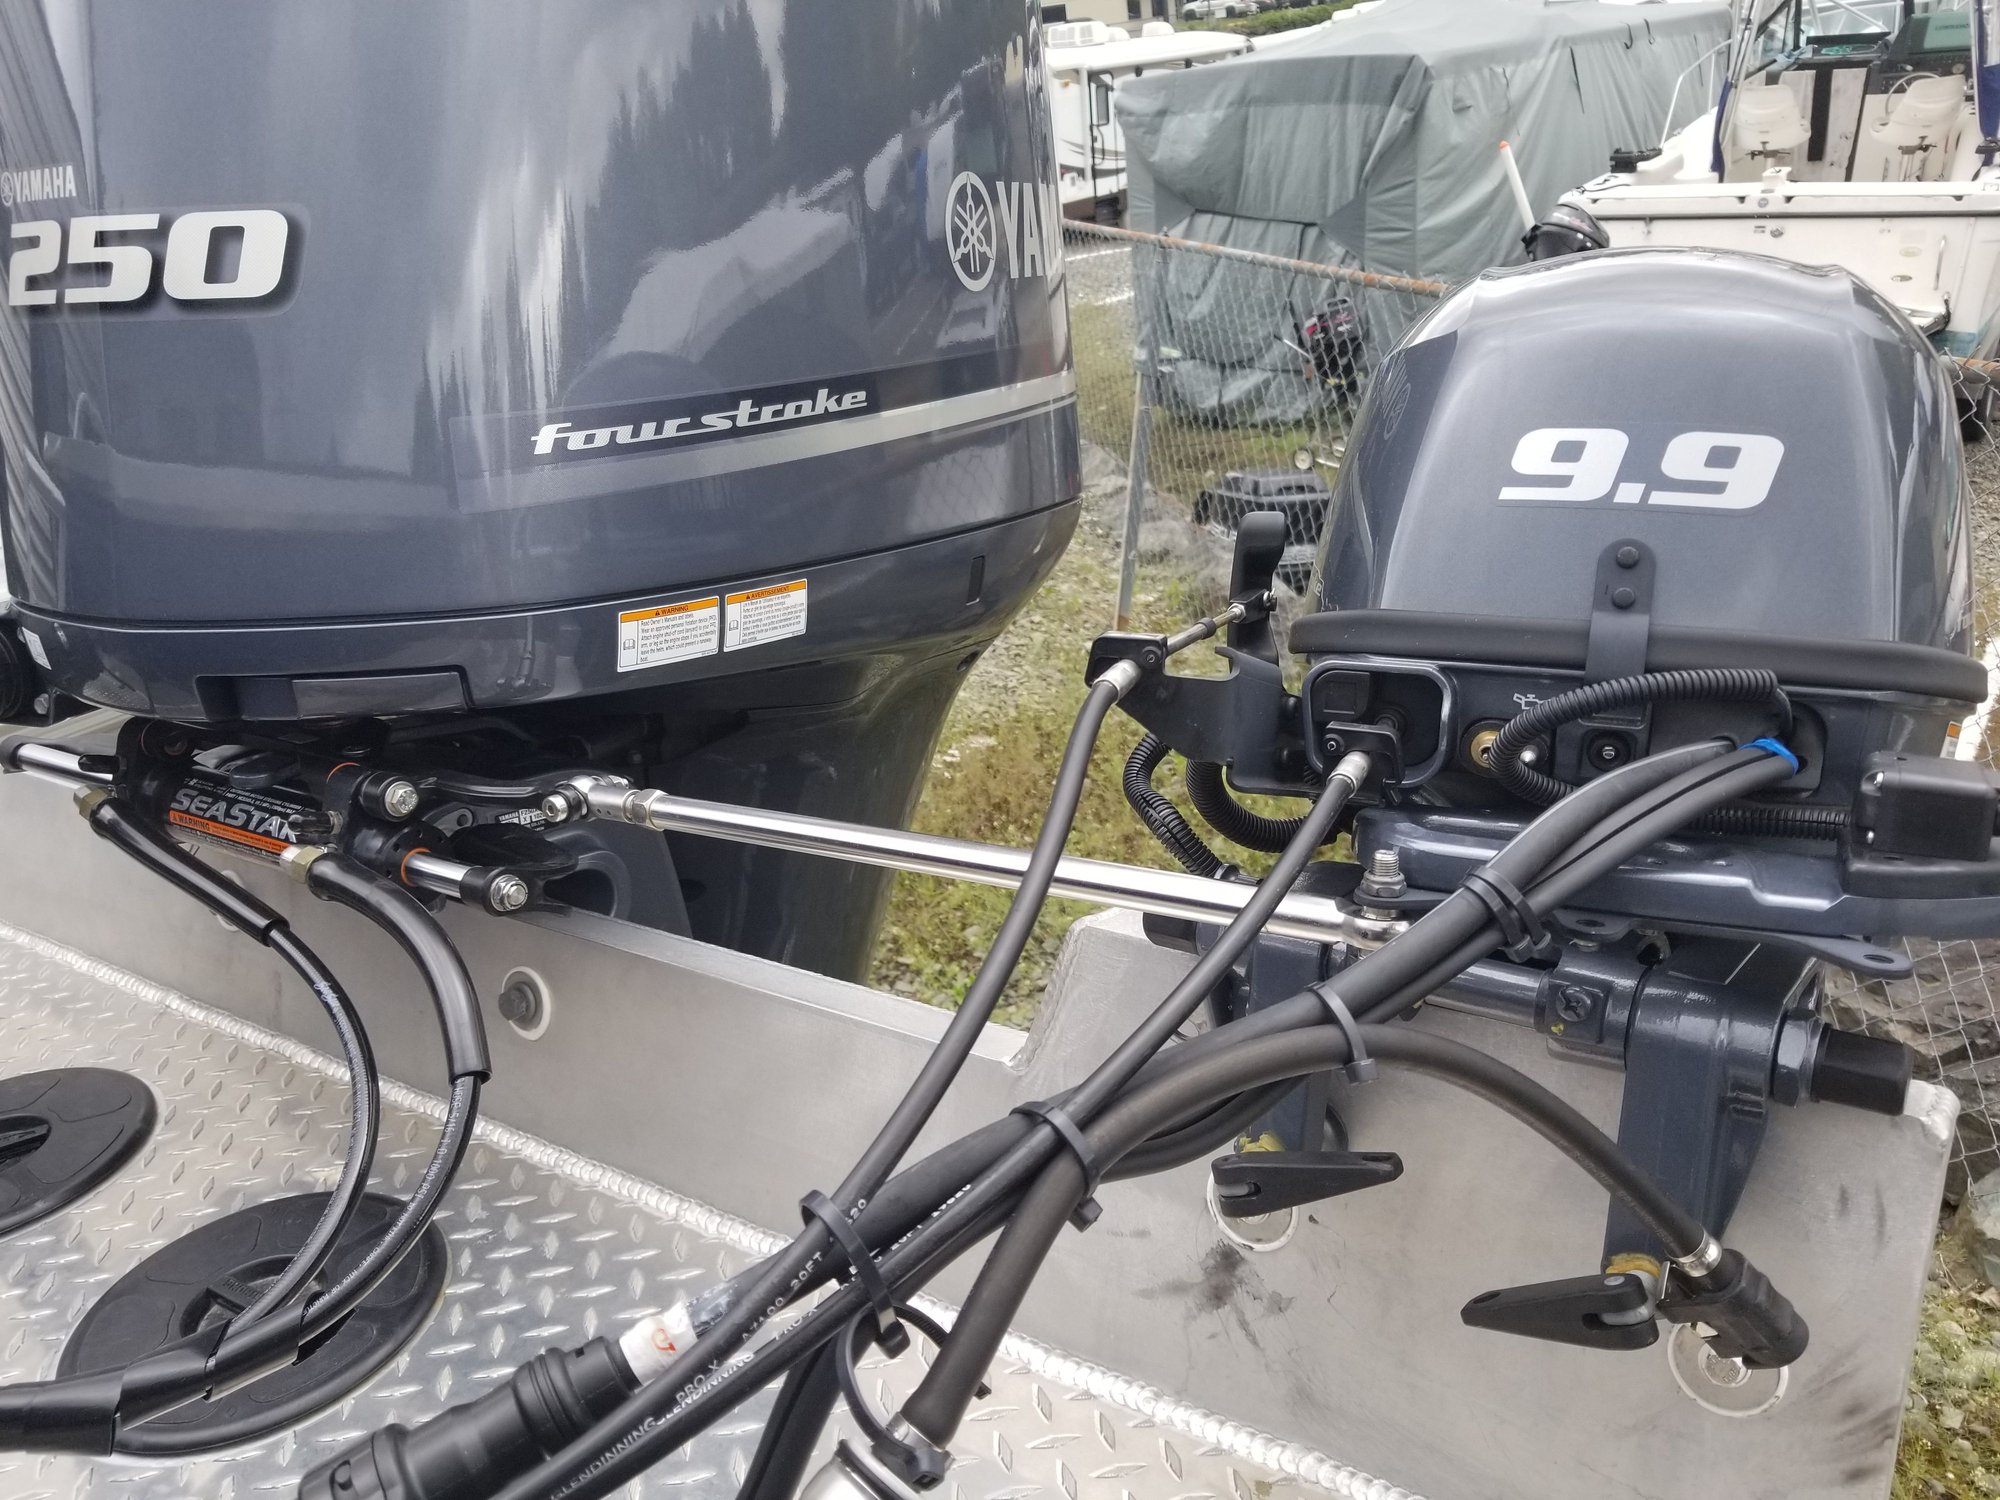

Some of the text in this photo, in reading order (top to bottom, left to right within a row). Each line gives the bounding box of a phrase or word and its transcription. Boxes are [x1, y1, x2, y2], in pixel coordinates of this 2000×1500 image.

[14, 165, 76, 201] YAMAHA
[9, 210, 288, 306] 250
[530, 388, 868, 455] four stroke
[1498, 427, 1785, 510] 9.9
[661, 605, 689, 614] WARNING
[751, 586, 789, 598] AVERTISSEMENT
[177, 813, 210, 831] WARNING
